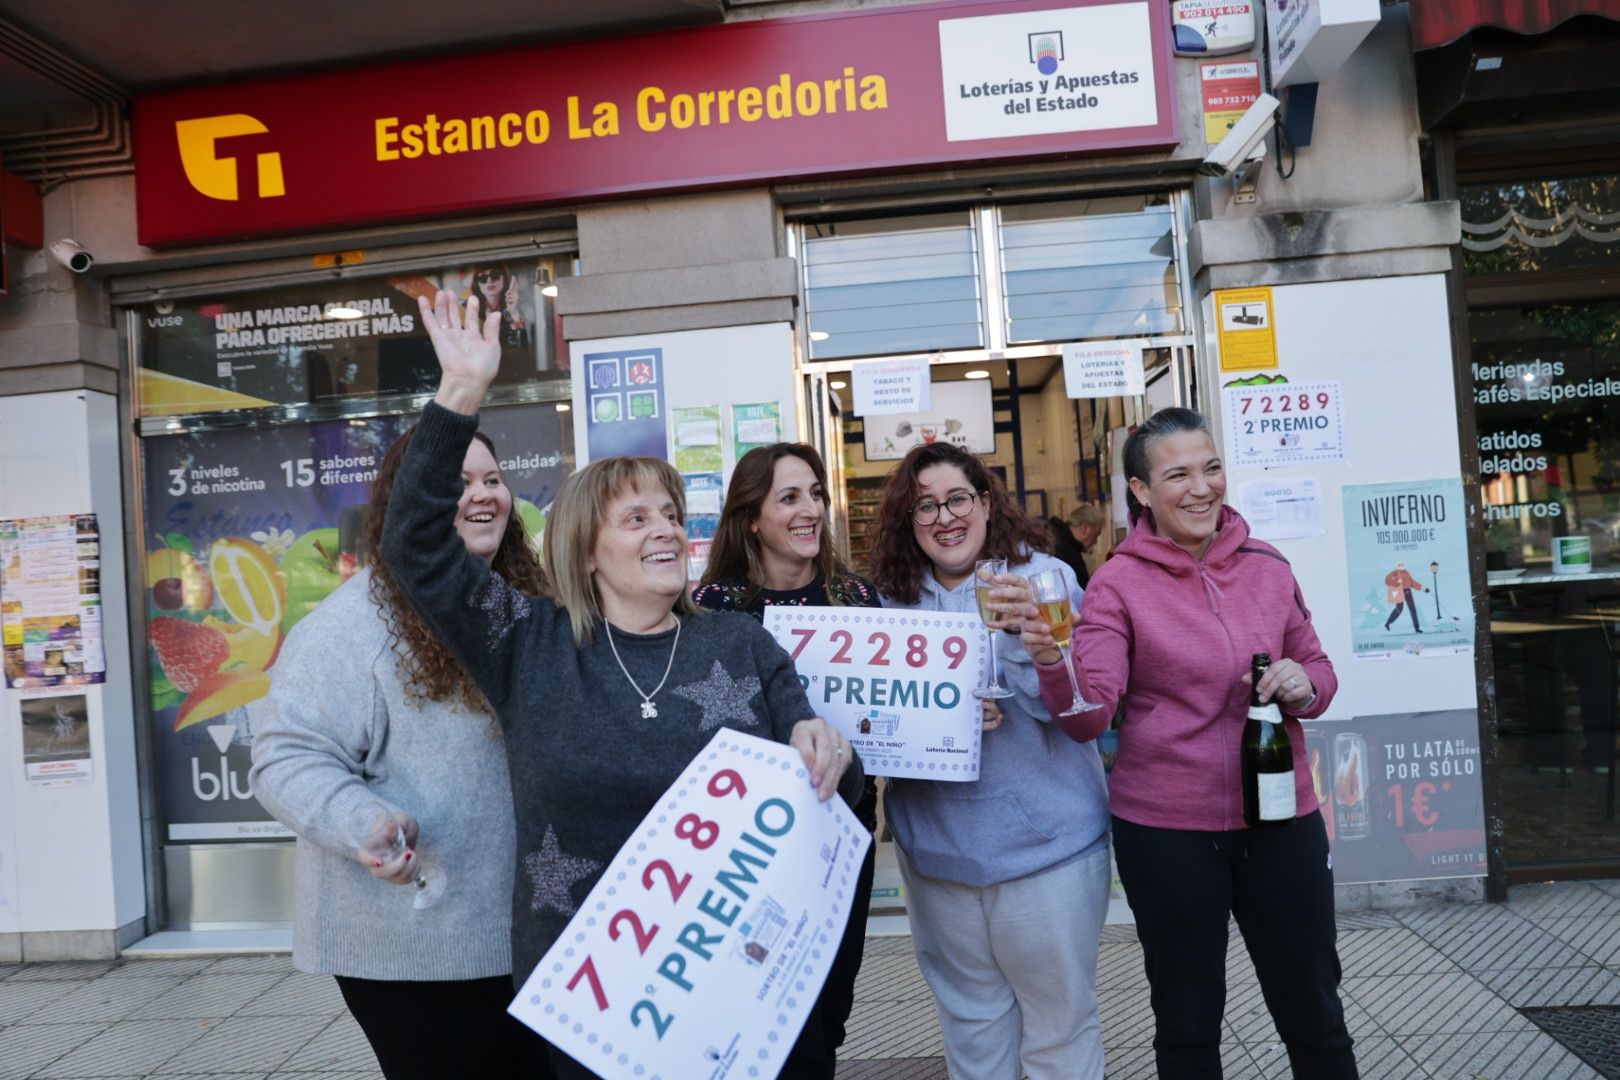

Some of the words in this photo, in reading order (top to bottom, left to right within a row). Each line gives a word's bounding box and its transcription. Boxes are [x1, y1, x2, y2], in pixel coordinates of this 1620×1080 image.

[1183, 9, 1202, 18] 902
[1204, 8, 1224, 16] 014
[960, 78, 1034, 98] Loterías
[1039, 81, 1049, 93] y
[1054, 69, 1139, 93] Apuestas
[375, 108, 549, 162] Estanco
[567, 96, 619, 139] La
[636, 67, 888, 134] Corredoria
[1003, 97, 1031, 115] del
[1036, 93, 1099, 113] Estado
[147, 315, 183, 328] vuse
[215, 310, 254, 330] UNA
[256, 304, 320, 326] MARCA
[216, 328, 265, 349] PARA
[267, 319, 369, 345] OFRECERTE
[372, 313, 414, 335] MÁS
[1098, 380, 1128, 388] ESTADO
[1474, 382, 1521, 405] afés
[873, 398, 914, 406] SERVICIOS
[1240, 392, 1329, 415] 72289
[1260, 415, 1329, 433] PREMIO
[1477, 430, 1542, 450] atidos
[280, 458, 315, 488] 15
[320, 455, 375, 470] sabores
[499, 454, 556, 471] caladas
[1478, 454, 1548, 474] elados
[168, 468, 188, 497] 3
[191, 464, 239, 479] niveles
[191, 480, 208, 494] de
[212, 476, 266, 493] nicotina
[320, 469, 378, 486] diferent
[1362, 494, 1446, 527] INVIERNO
[1483, 501, 1561, 521] hurros
[1376, 528, 1428, 545] 105.000.000
[1429, 528, 1436, 541] €
[790, 628, 967, 670] 72289
[823, 675, 961, 710] PREMIO
[1385, 743, 1405, 760] TU
[1413, 740, 1454, 758] LATA
[191, 756, 254, 801] blu
[1386, 762, 1420, 780] POR
[1429, 754, 1474, 777] SÓLO
[1431, 854, 1460, 865] LIGHT
[1464, 854, 1473, 863] IT
[566, 769, 748, 1012] 72289
[656, 798, 795, 993] PREMIO
[757, 965, 780, 1001] SORTEO
